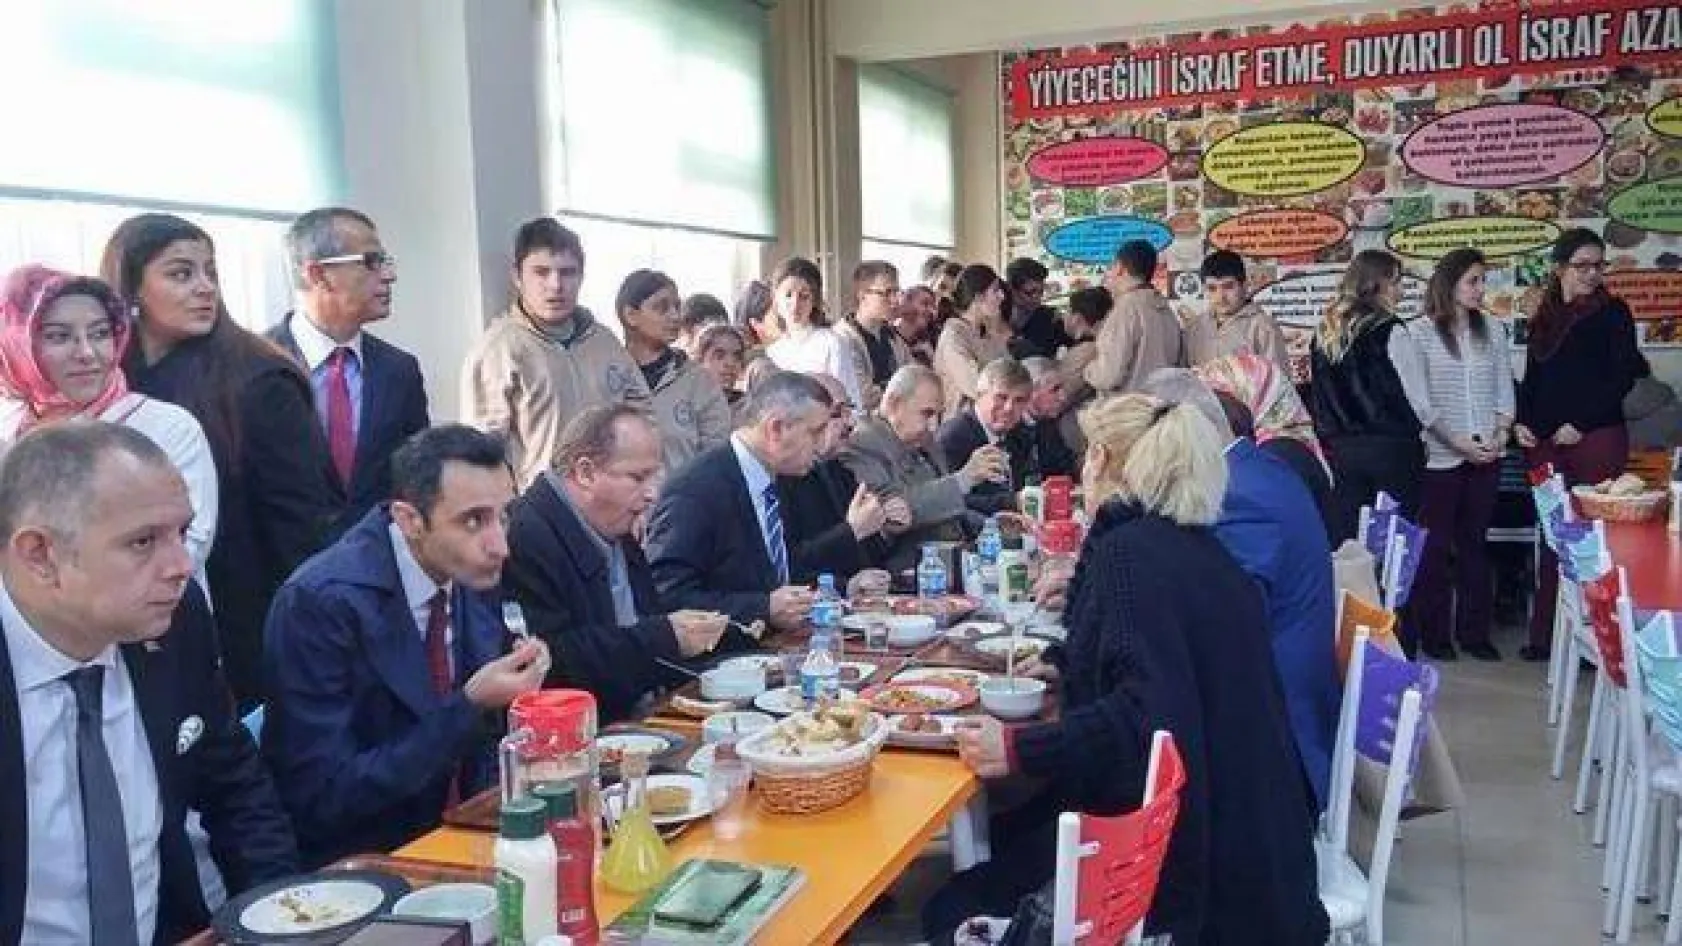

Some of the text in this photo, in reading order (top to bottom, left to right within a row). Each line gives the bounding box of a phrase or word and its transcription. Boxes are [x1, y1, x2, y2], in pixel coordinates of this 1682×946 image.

[1029, 54, 1160, 107] YİYECEĞİNİ
[1171, 50, 1248, 95] İSRAF
[1257, 41, 1334, 86] ETME,
[1345, 28, 1462, 78] DUYARLI
[1474, 24, 1509, 66] OL
[1519, 13, 1611, 61] İSRAF
